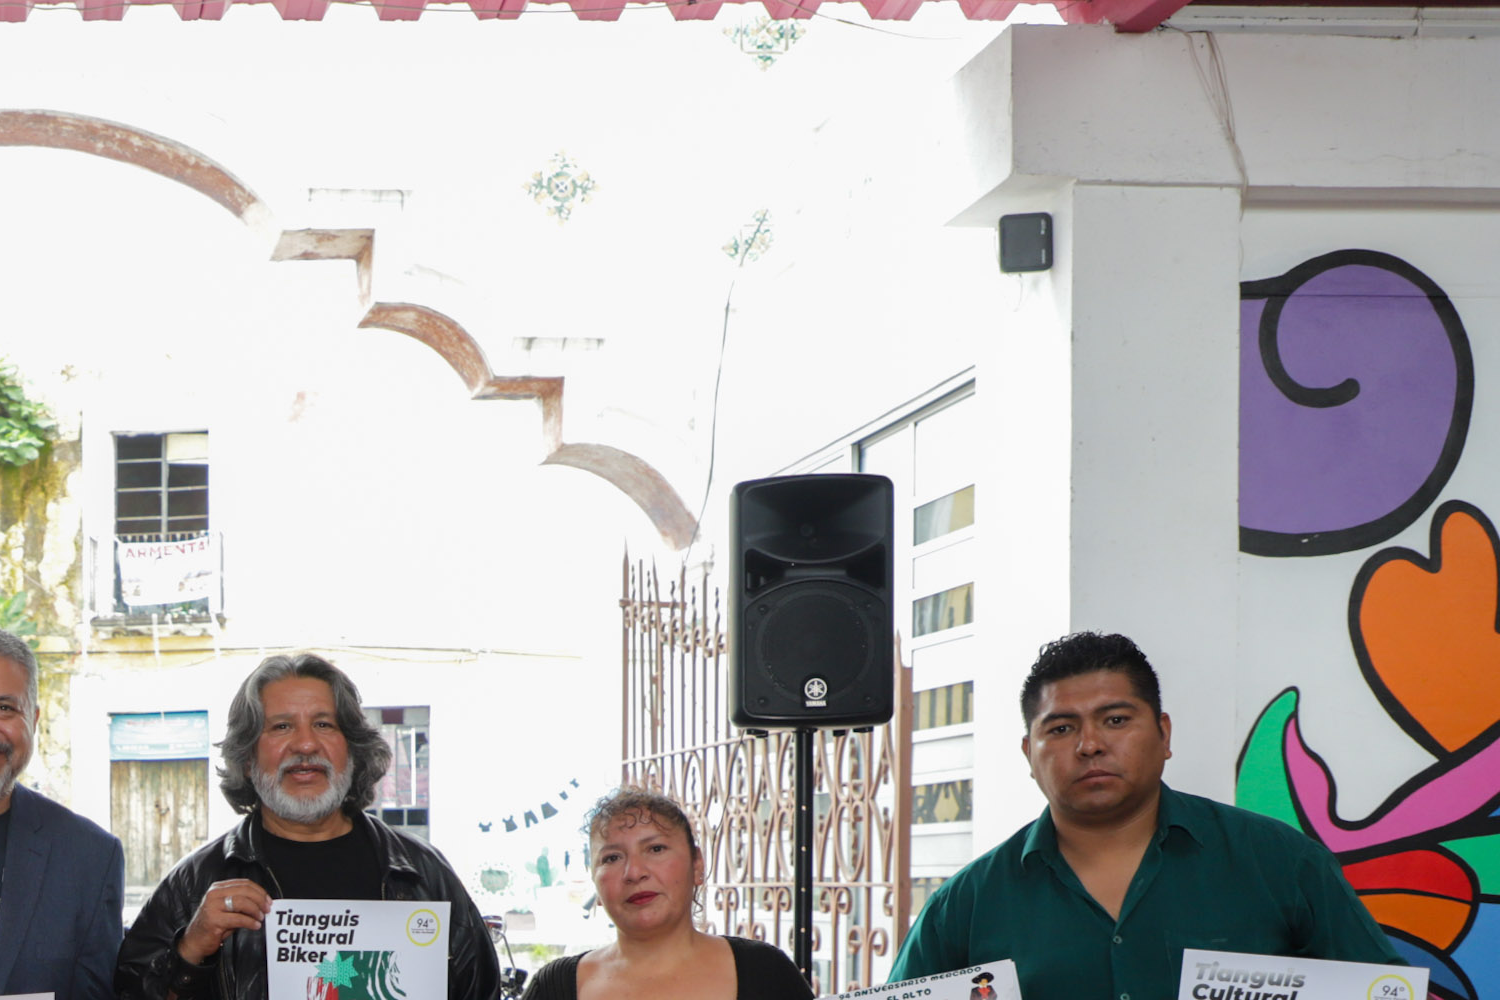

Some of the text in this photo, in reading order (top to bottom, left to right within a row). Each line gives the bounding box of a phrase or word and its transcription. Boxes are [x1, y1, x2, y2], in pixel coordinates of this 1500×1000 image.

[276, 910, 359, 929] Tianguis
[276, 929, 354, 945] Cultural
[277, 947, 327, 962] Biker
[1196, 962, 1305, 988] Tianguis
[855, 978, 926, 997] ANIVERSARIO
[902, 989, 931, 1000] ALTO
